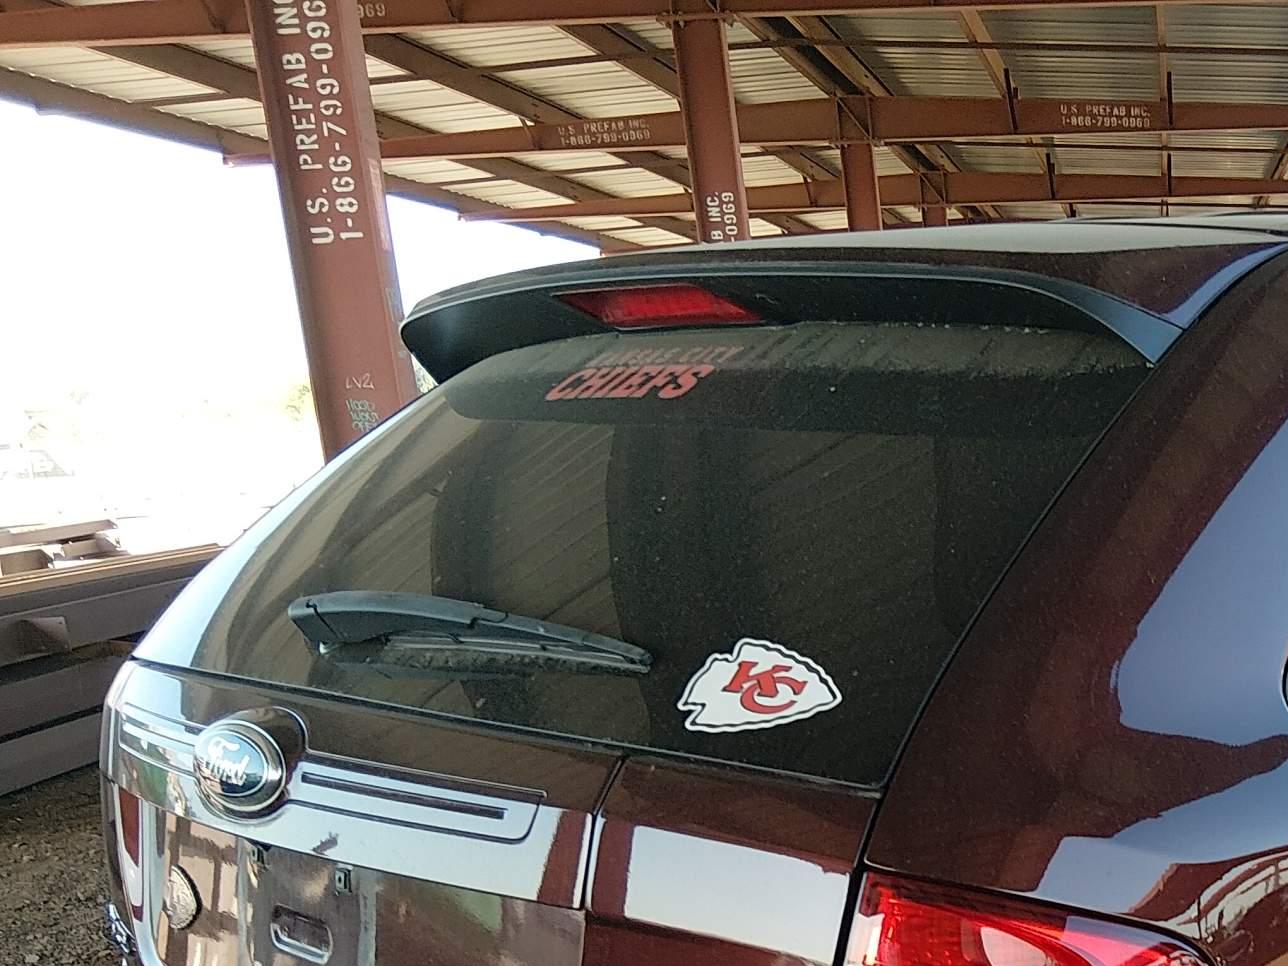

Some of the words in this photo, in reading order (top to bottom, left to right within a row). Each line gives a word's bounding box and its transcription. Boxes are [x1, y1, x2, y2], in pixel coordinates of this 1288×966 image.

[273, 0, 301, 35] IN
[282, 52, 324, 170] PREFAB
[306, 187, 335, 245] U.S.
[545, 364, 716, 401] CHIEFS
[721, 660, 808, 714] KC
[205, 736, 251, 787] Ford
